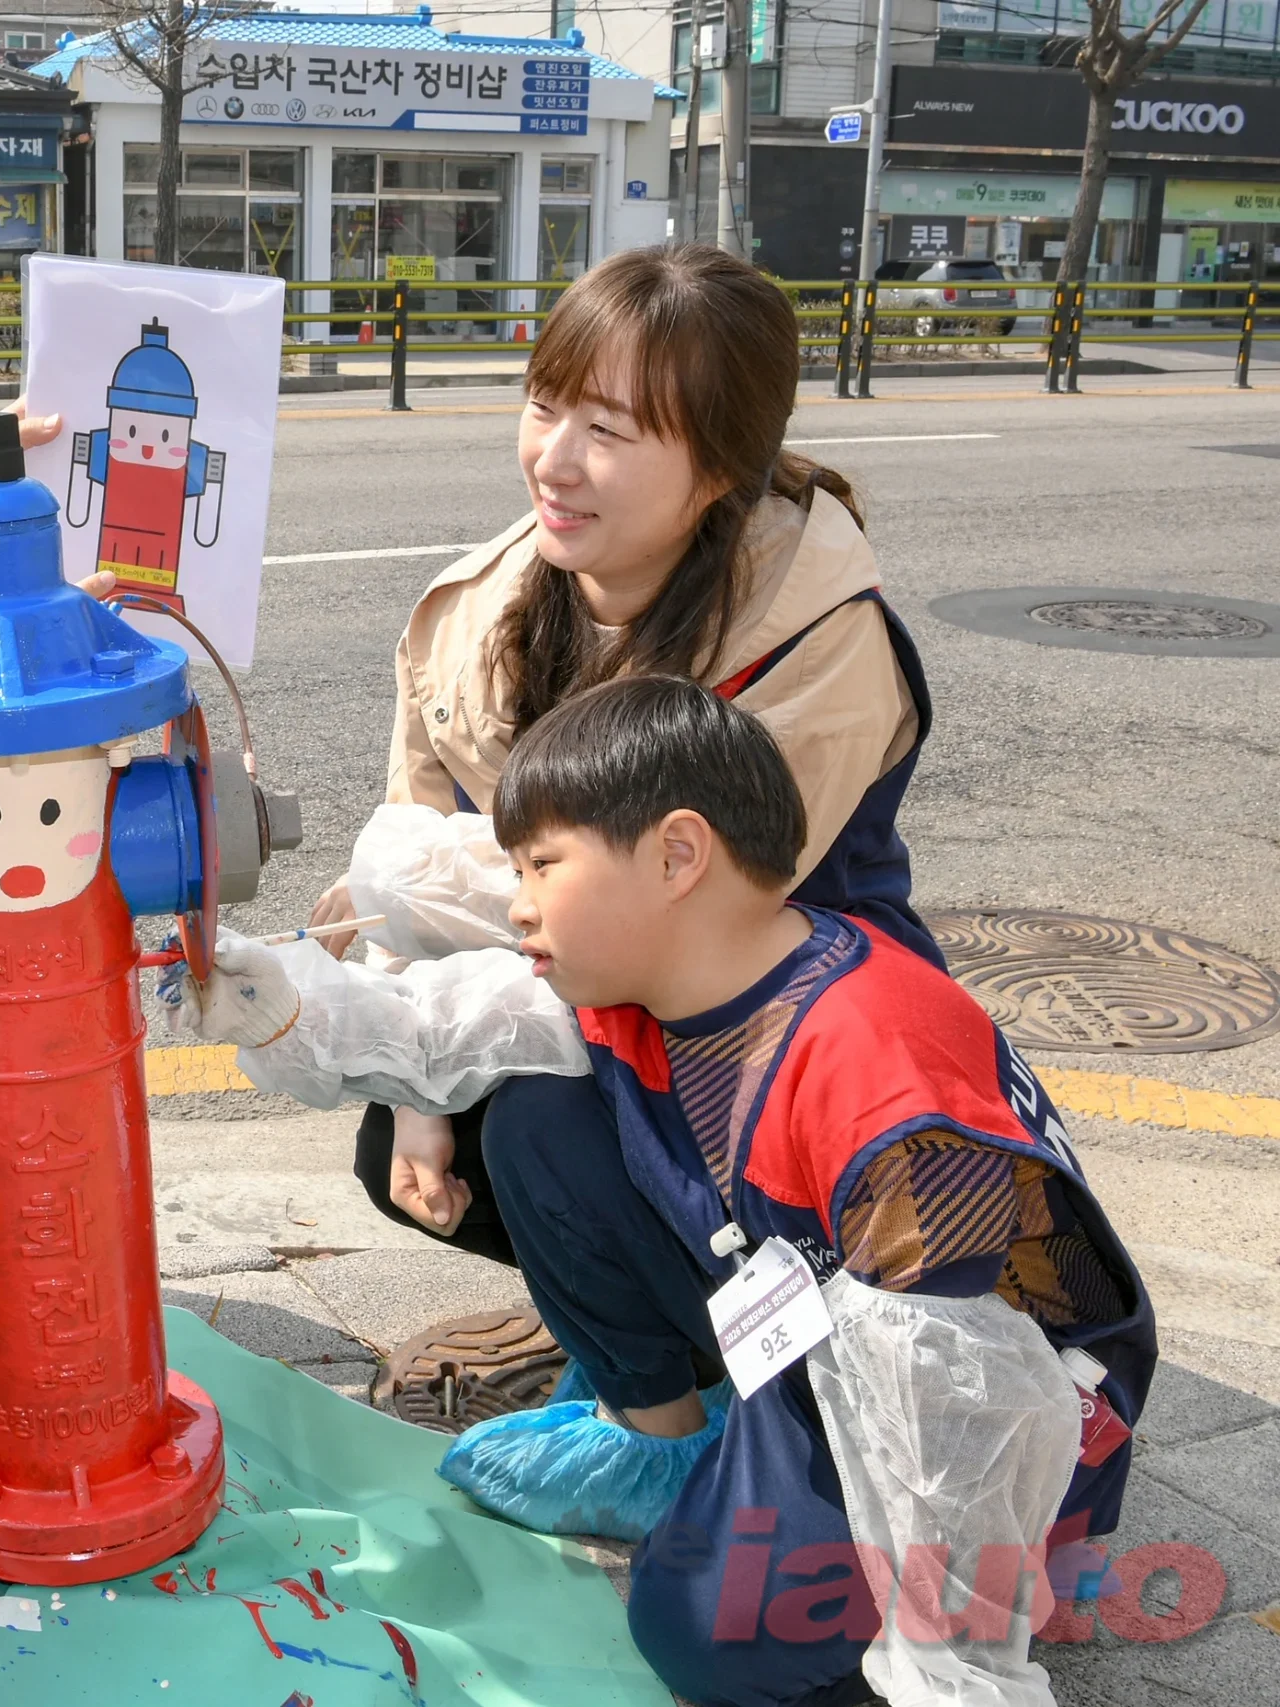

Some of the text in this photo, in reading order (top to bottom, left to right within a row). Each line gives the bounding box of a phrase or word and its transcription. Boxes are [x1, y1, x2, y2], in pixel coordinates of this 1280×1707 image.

[197, 53, 507, 100] 수입차 국산차 정비샵
[535, 62, 583, 76] 엔진오일
[534, 79, 582, 93] 잔유제거
[914, 100, 974, 113] ALWAYS NEW
[1111, 98, 1246, 135] CUCKOO
[910, 225, 949, 249] 쿠쿠
[724, 1326, 742, 1346] 2026
[740, 1301, 773, 1332] 현대모비스
[760, 1323, 793, 1361] 9조
